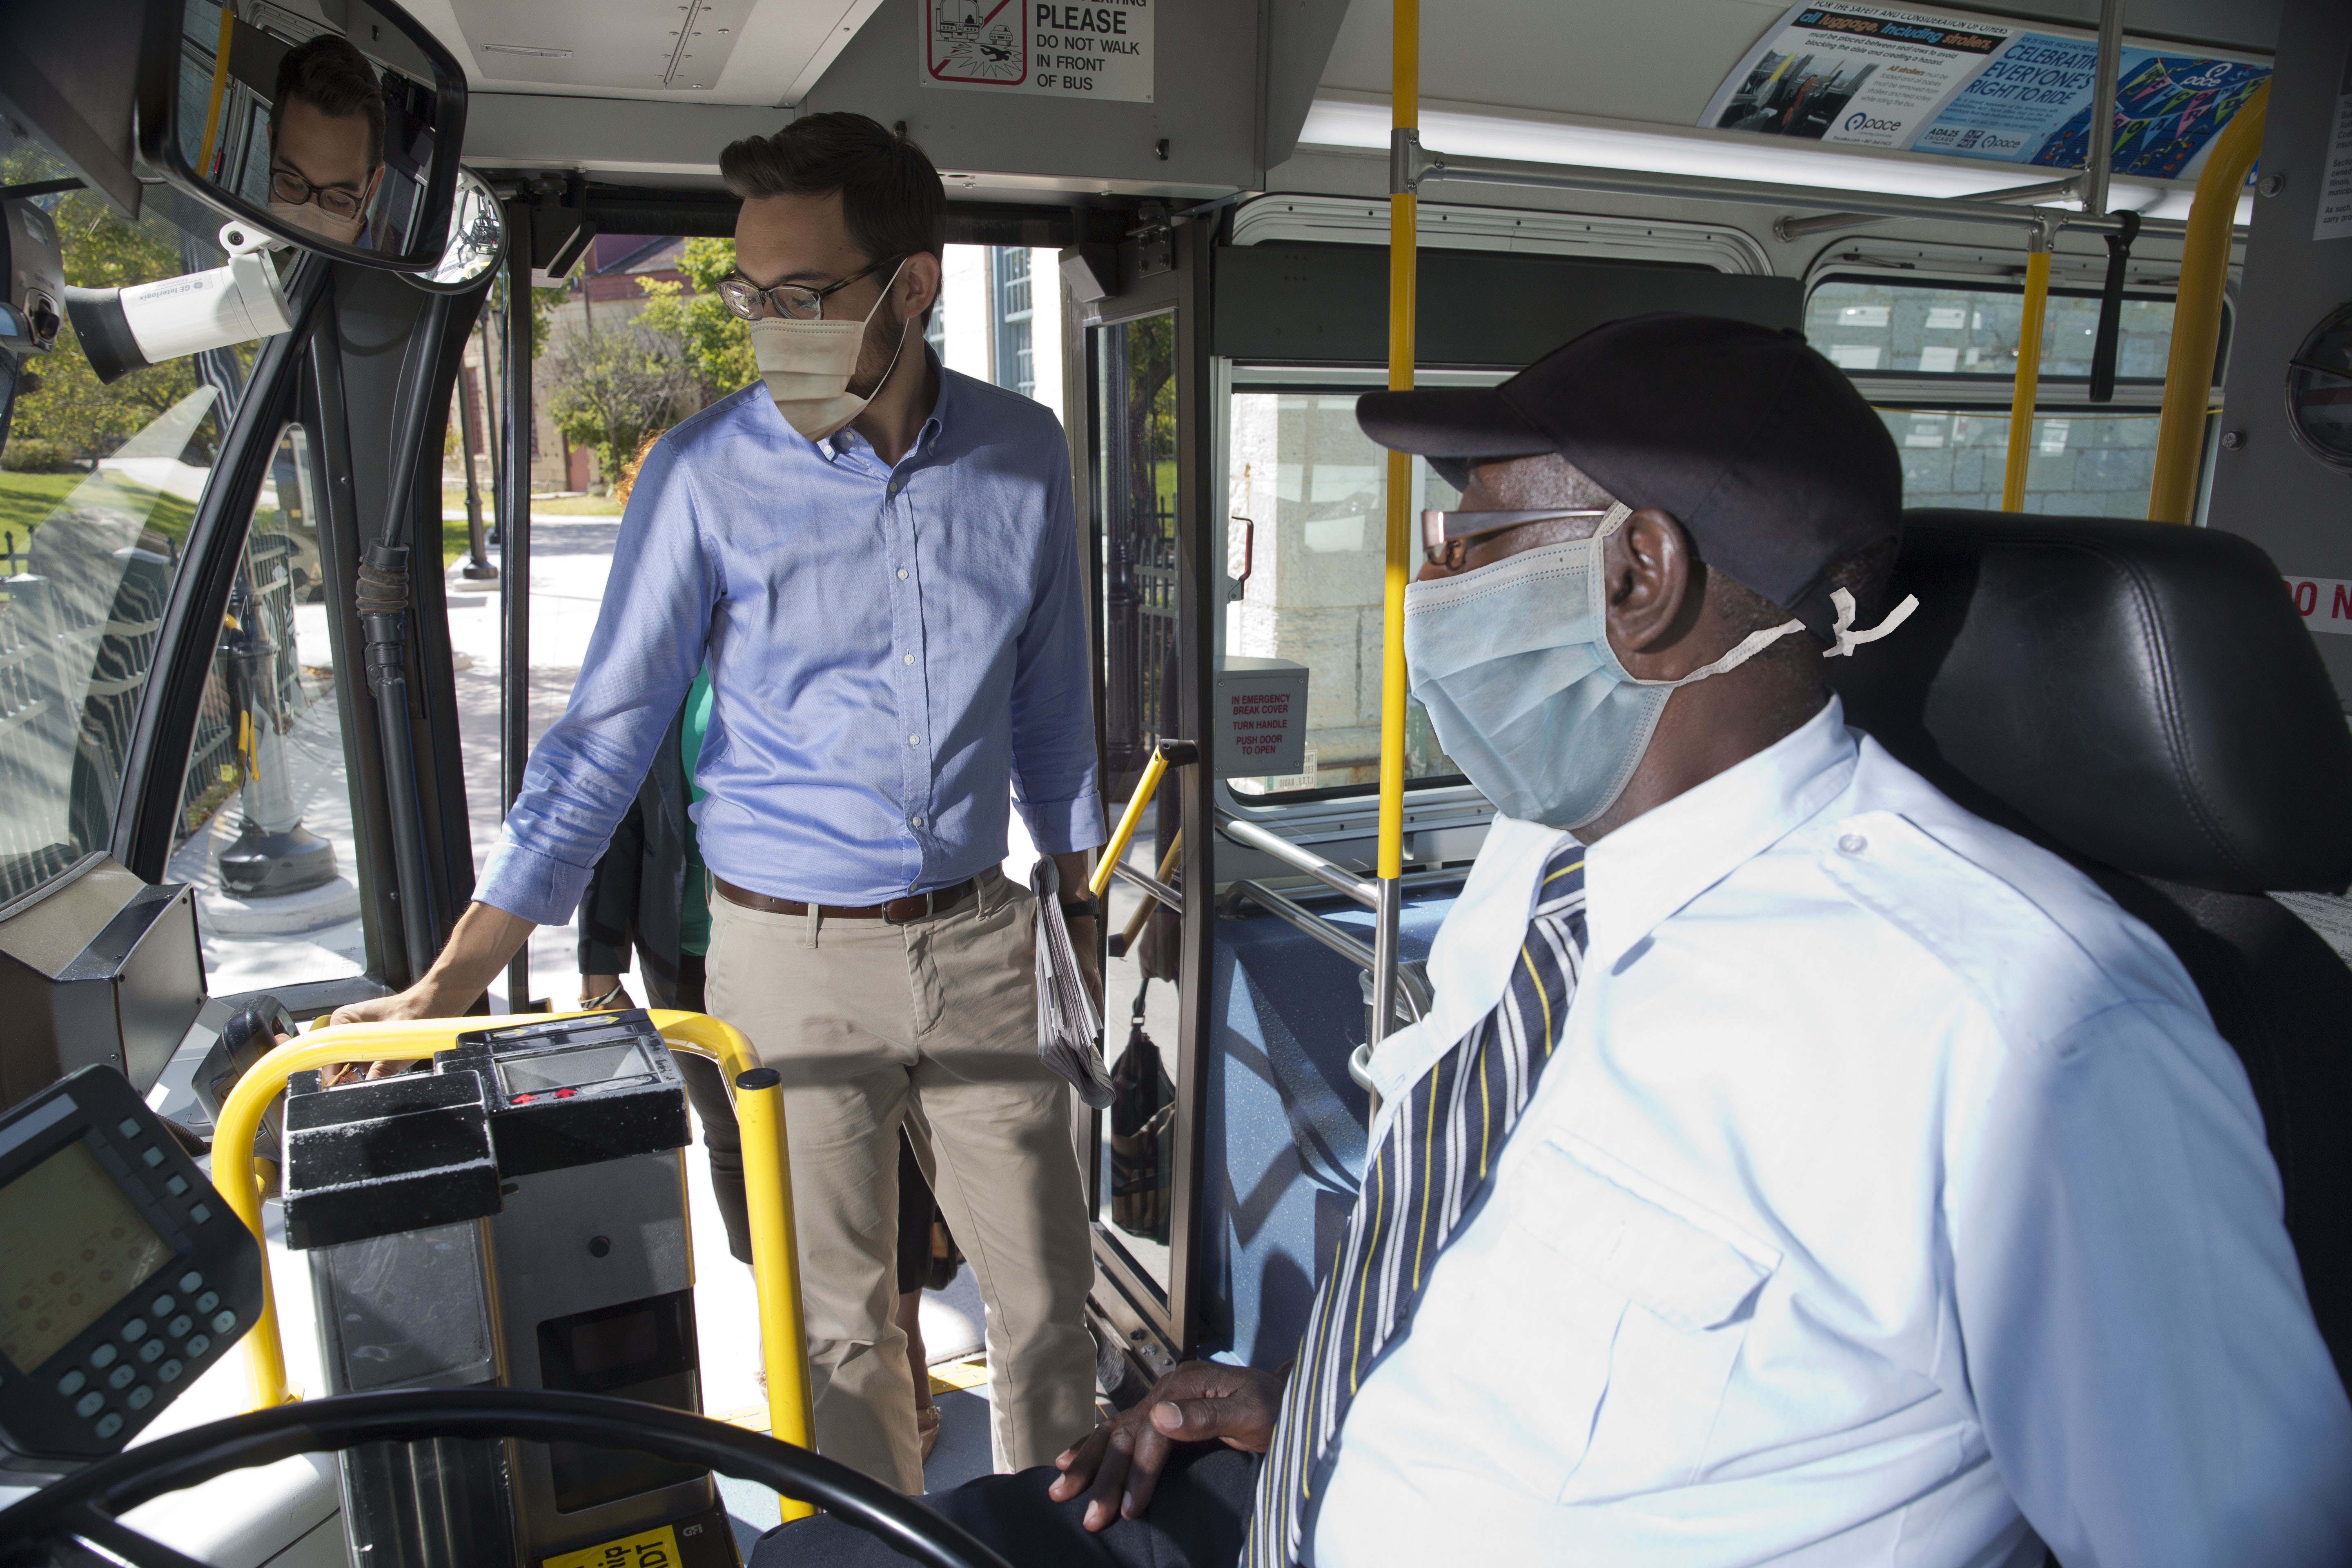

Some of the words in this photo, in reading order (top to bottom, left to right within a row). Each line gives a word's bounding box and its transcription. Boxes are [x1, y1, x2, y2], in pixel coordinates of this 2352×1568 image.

[1834, 3, 1849, 11] THE
[1037, 3, 1127, 34] PLEASE
[1800, 12, 1823, 23] all
[1818, 13, 1878, 33] luggage,
[1880, 22, 1944, 43] including
[1942, 33, 1992, 50] strollers,
[1037, 34, 1058, 48] DO
[1065, 36, 1094, 51] NOT
[1100, 39, 1140, 55] WALK
[1805, 39, 1837, 49] blocking
[1850, 45, 1867, 53] aisle
[1867, 48, 1884, 56] and
[1882, 51, 1912, 61] creating
[1837, 35, 1865, 44] placed
[1864, 39, 1896, 49] between
[1937, 51, 1959, 59] avoid
[1037, 53, 1050, 67] IN
[1056, 55, 1105, 71] FRONT
[2004, 45, 2098, 70] CELEBRATIN
[1037, 74, 1057, 87] OF
[1063, 75, 1093, 90] BUS
[1982, 61, 2095, 90] EVERYONE'S
[2179, 76, 2221, 87] pace
[1965, 79, 2020, 98] RIGHT
[2013, 87, 2040, 102] TO
[2035, 89, 2077, 105] RIDE
[1861, 118, 1901, 131] pace
[1993, 138, 2020, 148] pace
[2328, 188, 2352, 196] municip
[139, 287, 177, 301] Interlogix
[1231, 696, 1240, 704] IN
[1242, 694, 1290, 704] EMERGENCY
[1233, 706, 1259, 715] BREAK
[1262, 704, 1288, 714] COVER
[1233, 721, 1254, 730] TURN
[1256, 719, 1287, 729] HANDLE
[1236, 736, 1258, 745] PUSH
[1260, 735, 1282, 743] DOOR
[1242, 746, 1253, 755] TO
[1254, 746, 1276, 754] OPEN
